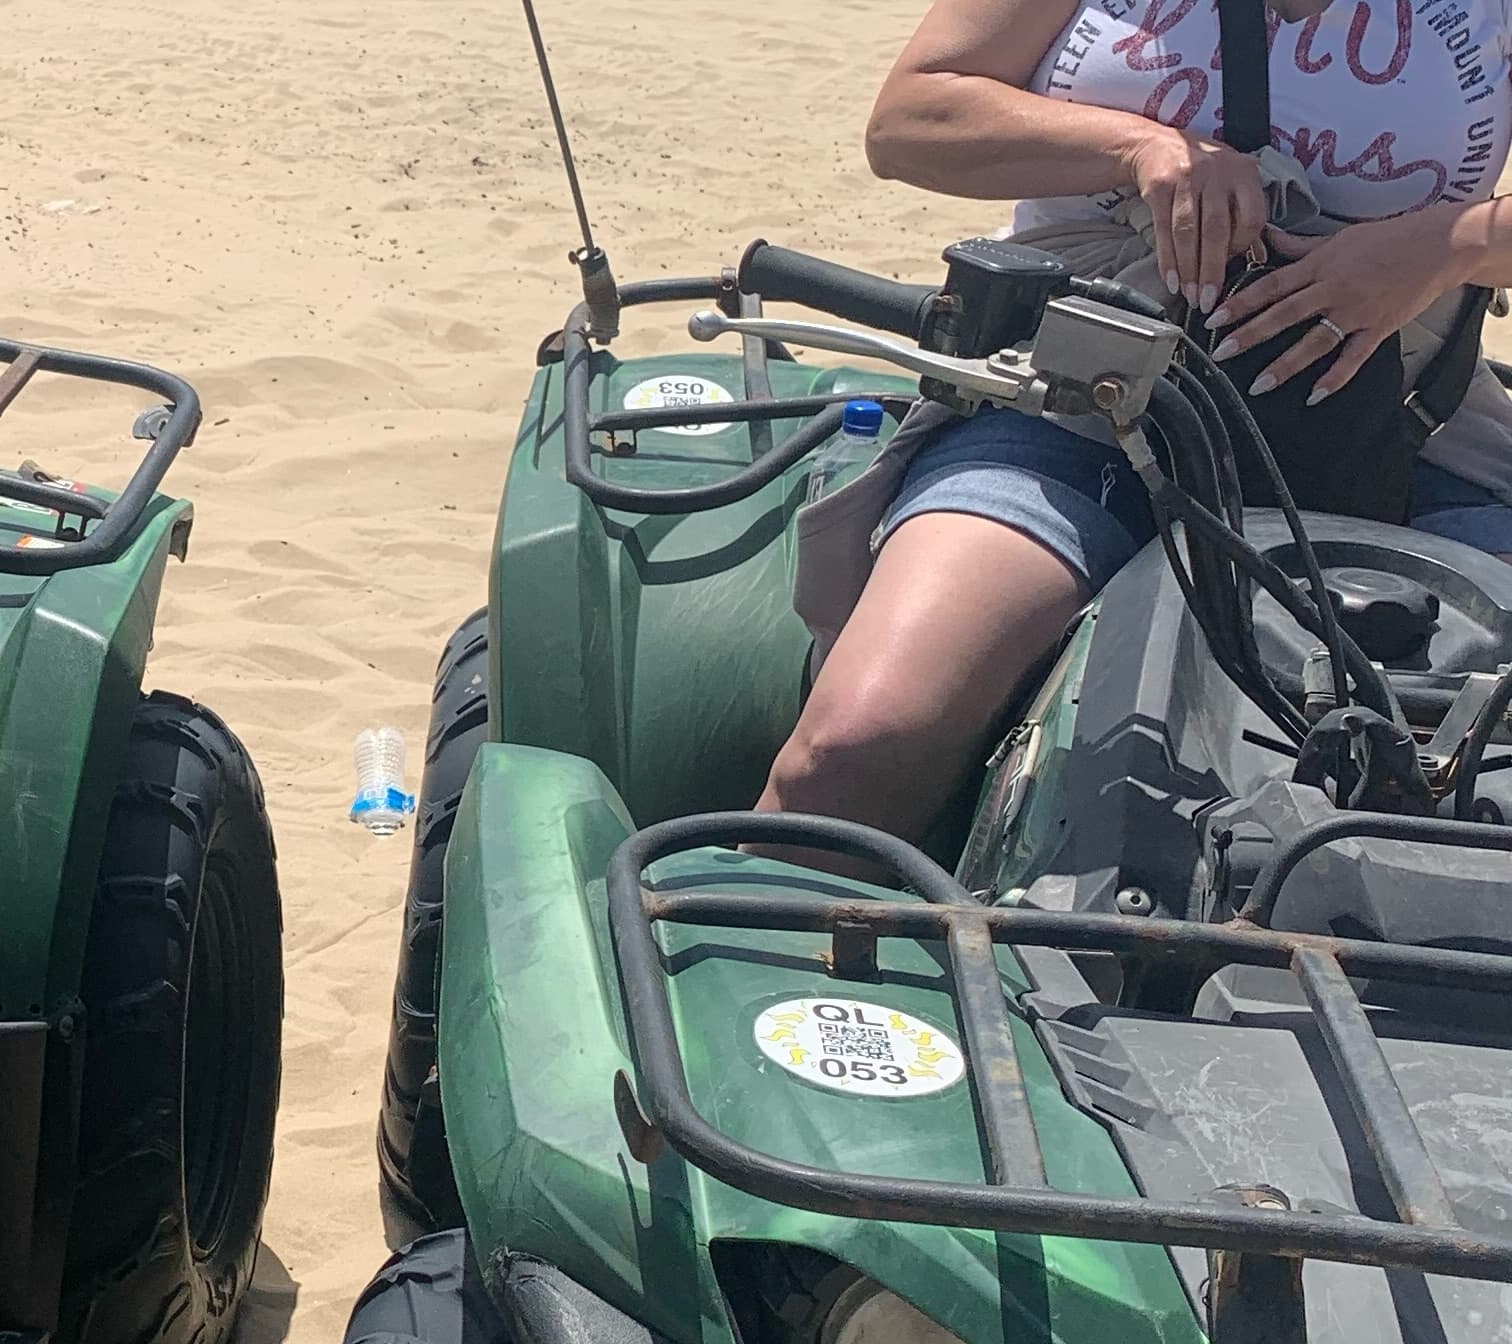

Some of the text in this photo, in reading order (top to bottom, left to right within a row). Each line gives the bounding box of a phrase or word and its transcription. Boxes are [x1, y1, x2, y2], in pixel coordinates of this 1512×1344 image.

[659, 382, 705, 395] 053
[812, 1003, 885, 1027] QL
[819, 1058, 909, 1085] 053
